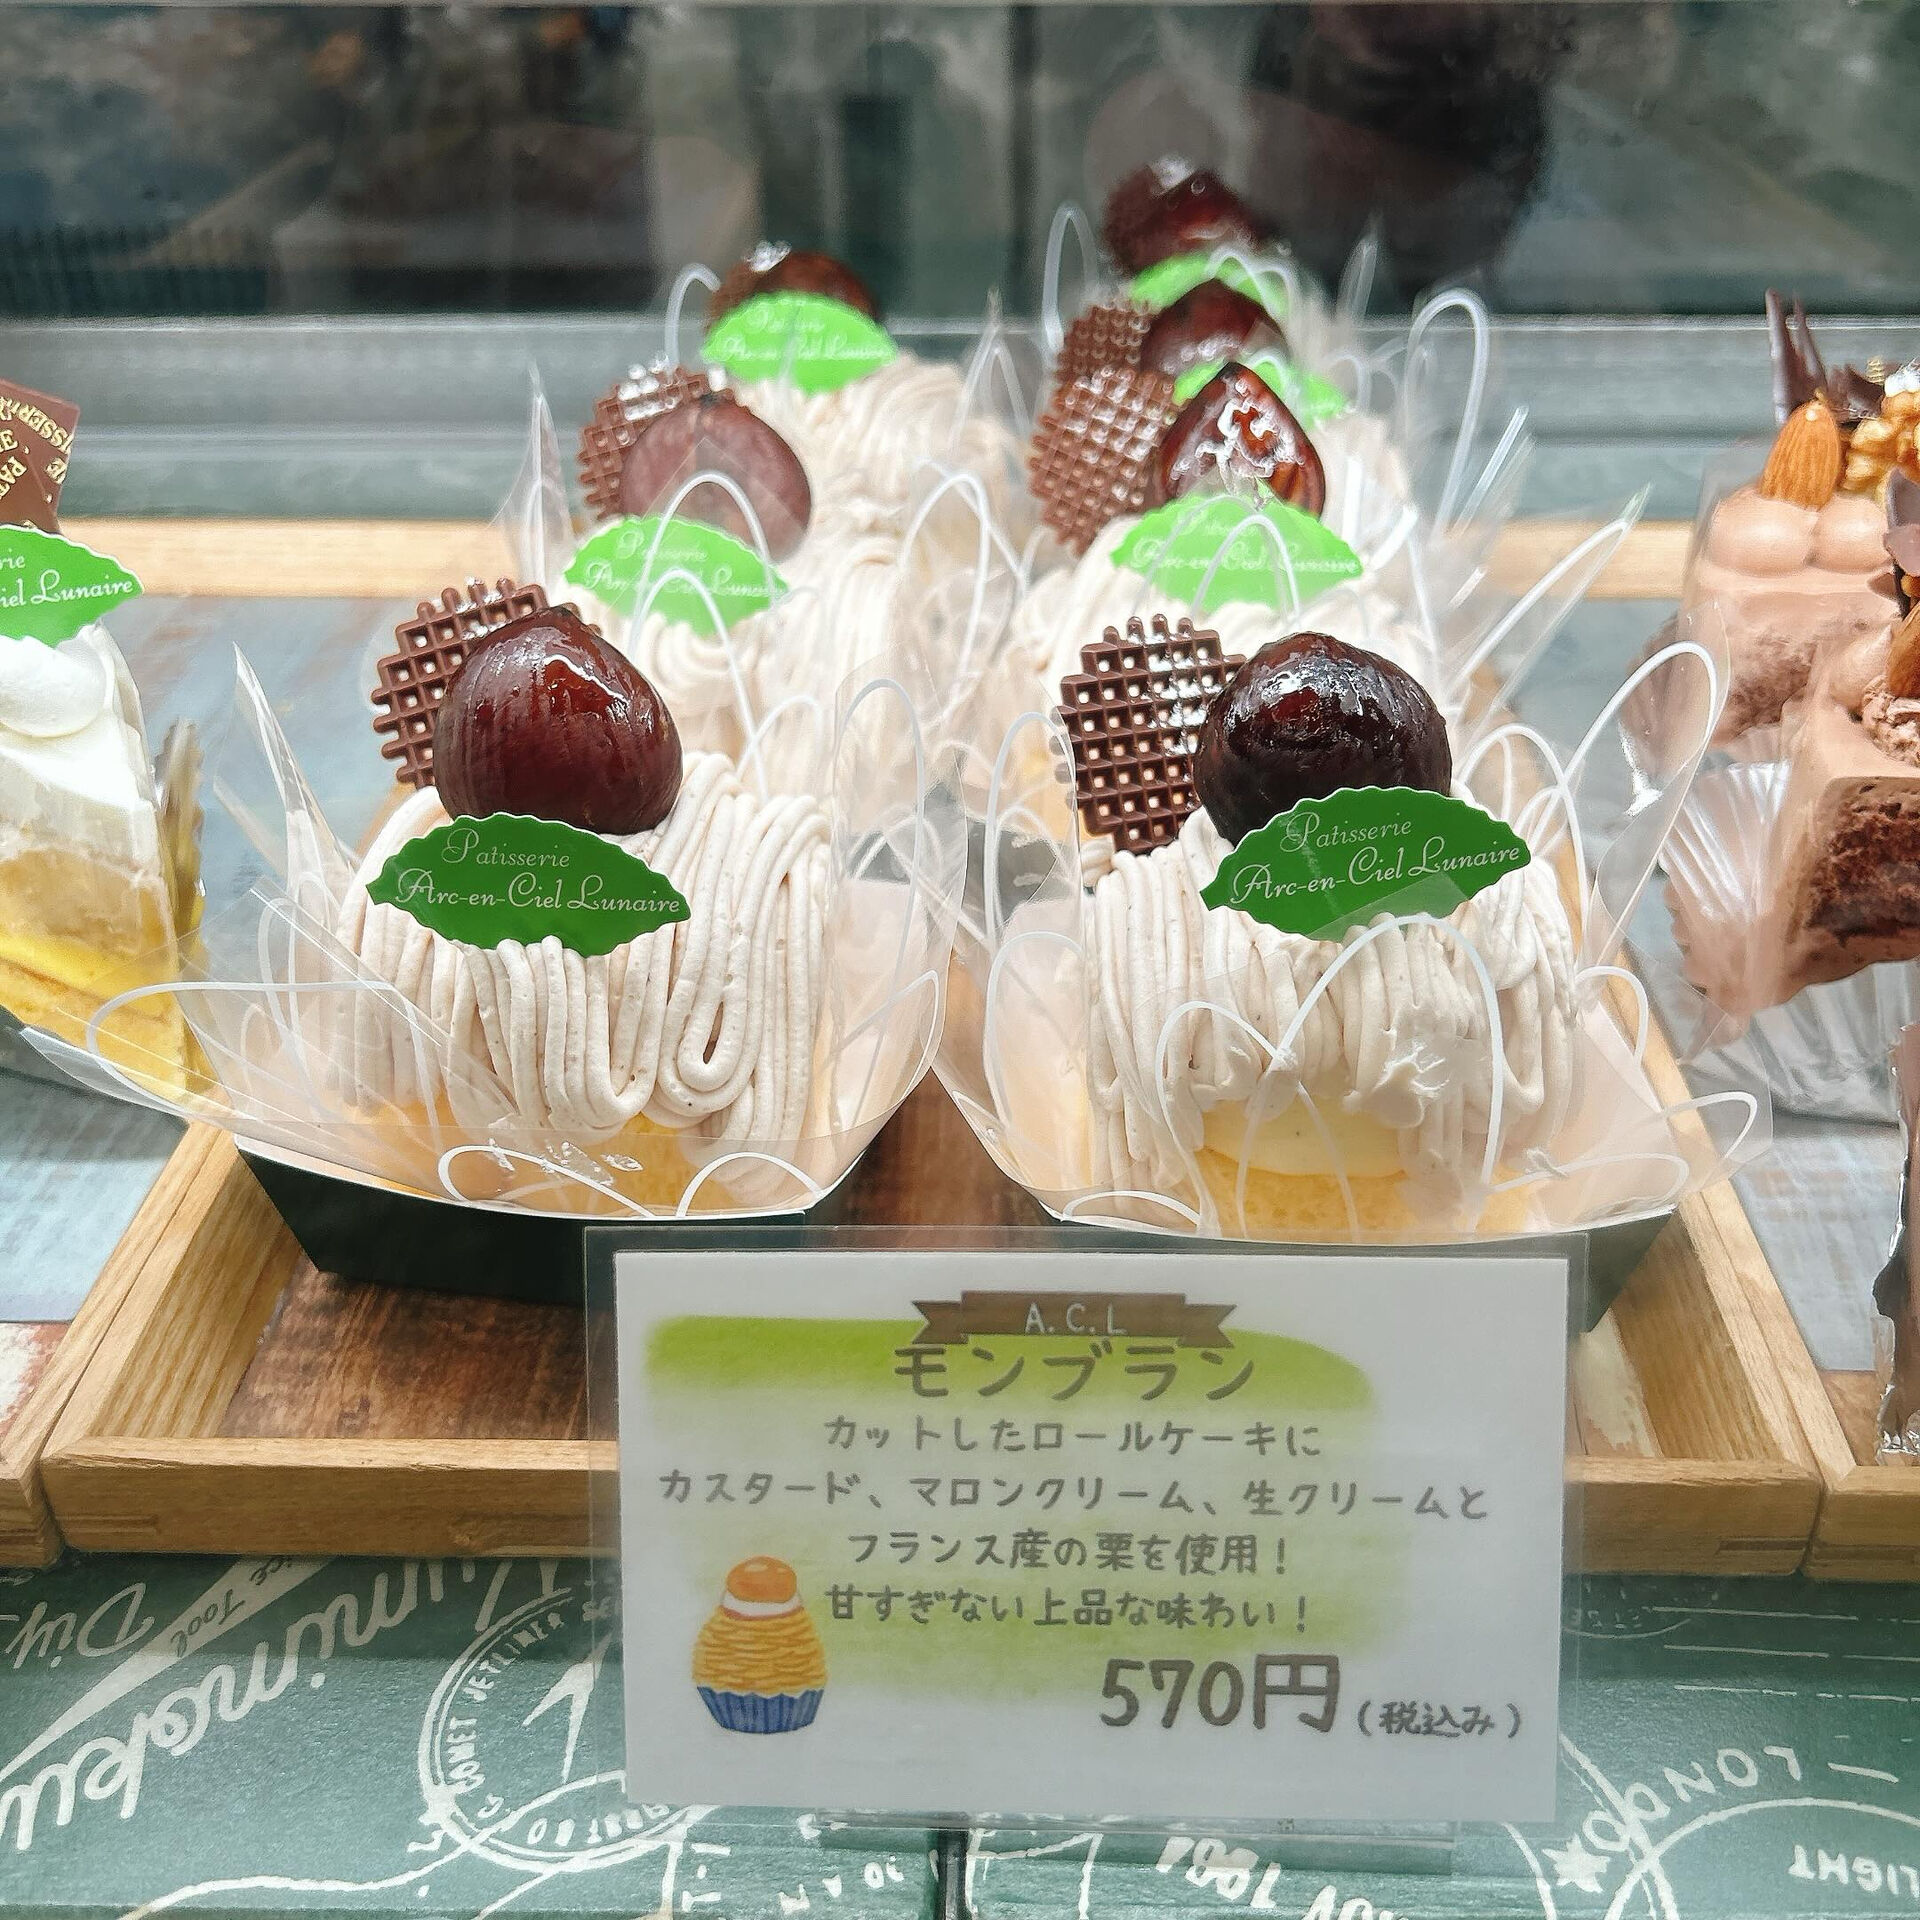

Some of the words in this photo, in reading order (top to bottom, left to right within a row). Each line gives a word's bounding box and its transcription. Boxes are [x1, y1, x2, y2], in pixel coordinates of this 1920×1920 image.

[30, 569, 133, 604] Lunaire
[441, 827, 570, 868] Patisserie
[1279, 811, 1412, 853] Patisserie
[395, 867, 562, 909] Arc-en-Ciel
[566, 874, 680, 913] Lunaire
[1229, 845, 1403, 904] Arc-en-Ciel
[1407, 836, 1520, 877] Lunaire
[894, 1339, 1255, 1401] モンブラン
[824, 1414, 1321, 1457] カットしたロールケーキに
[658, 1468, 1488, 1520] カスタード、マロンクリーム、生クリームと
[847, 1527, 1287, 1577] フランス産の栗を使用！
[824, 1583, 1307, 1634] 甘すぎない上品な味わい！
[1099, 1653, 1341, 1733] 570円
[1356, 1699, 1522, 1739] (税込み)
